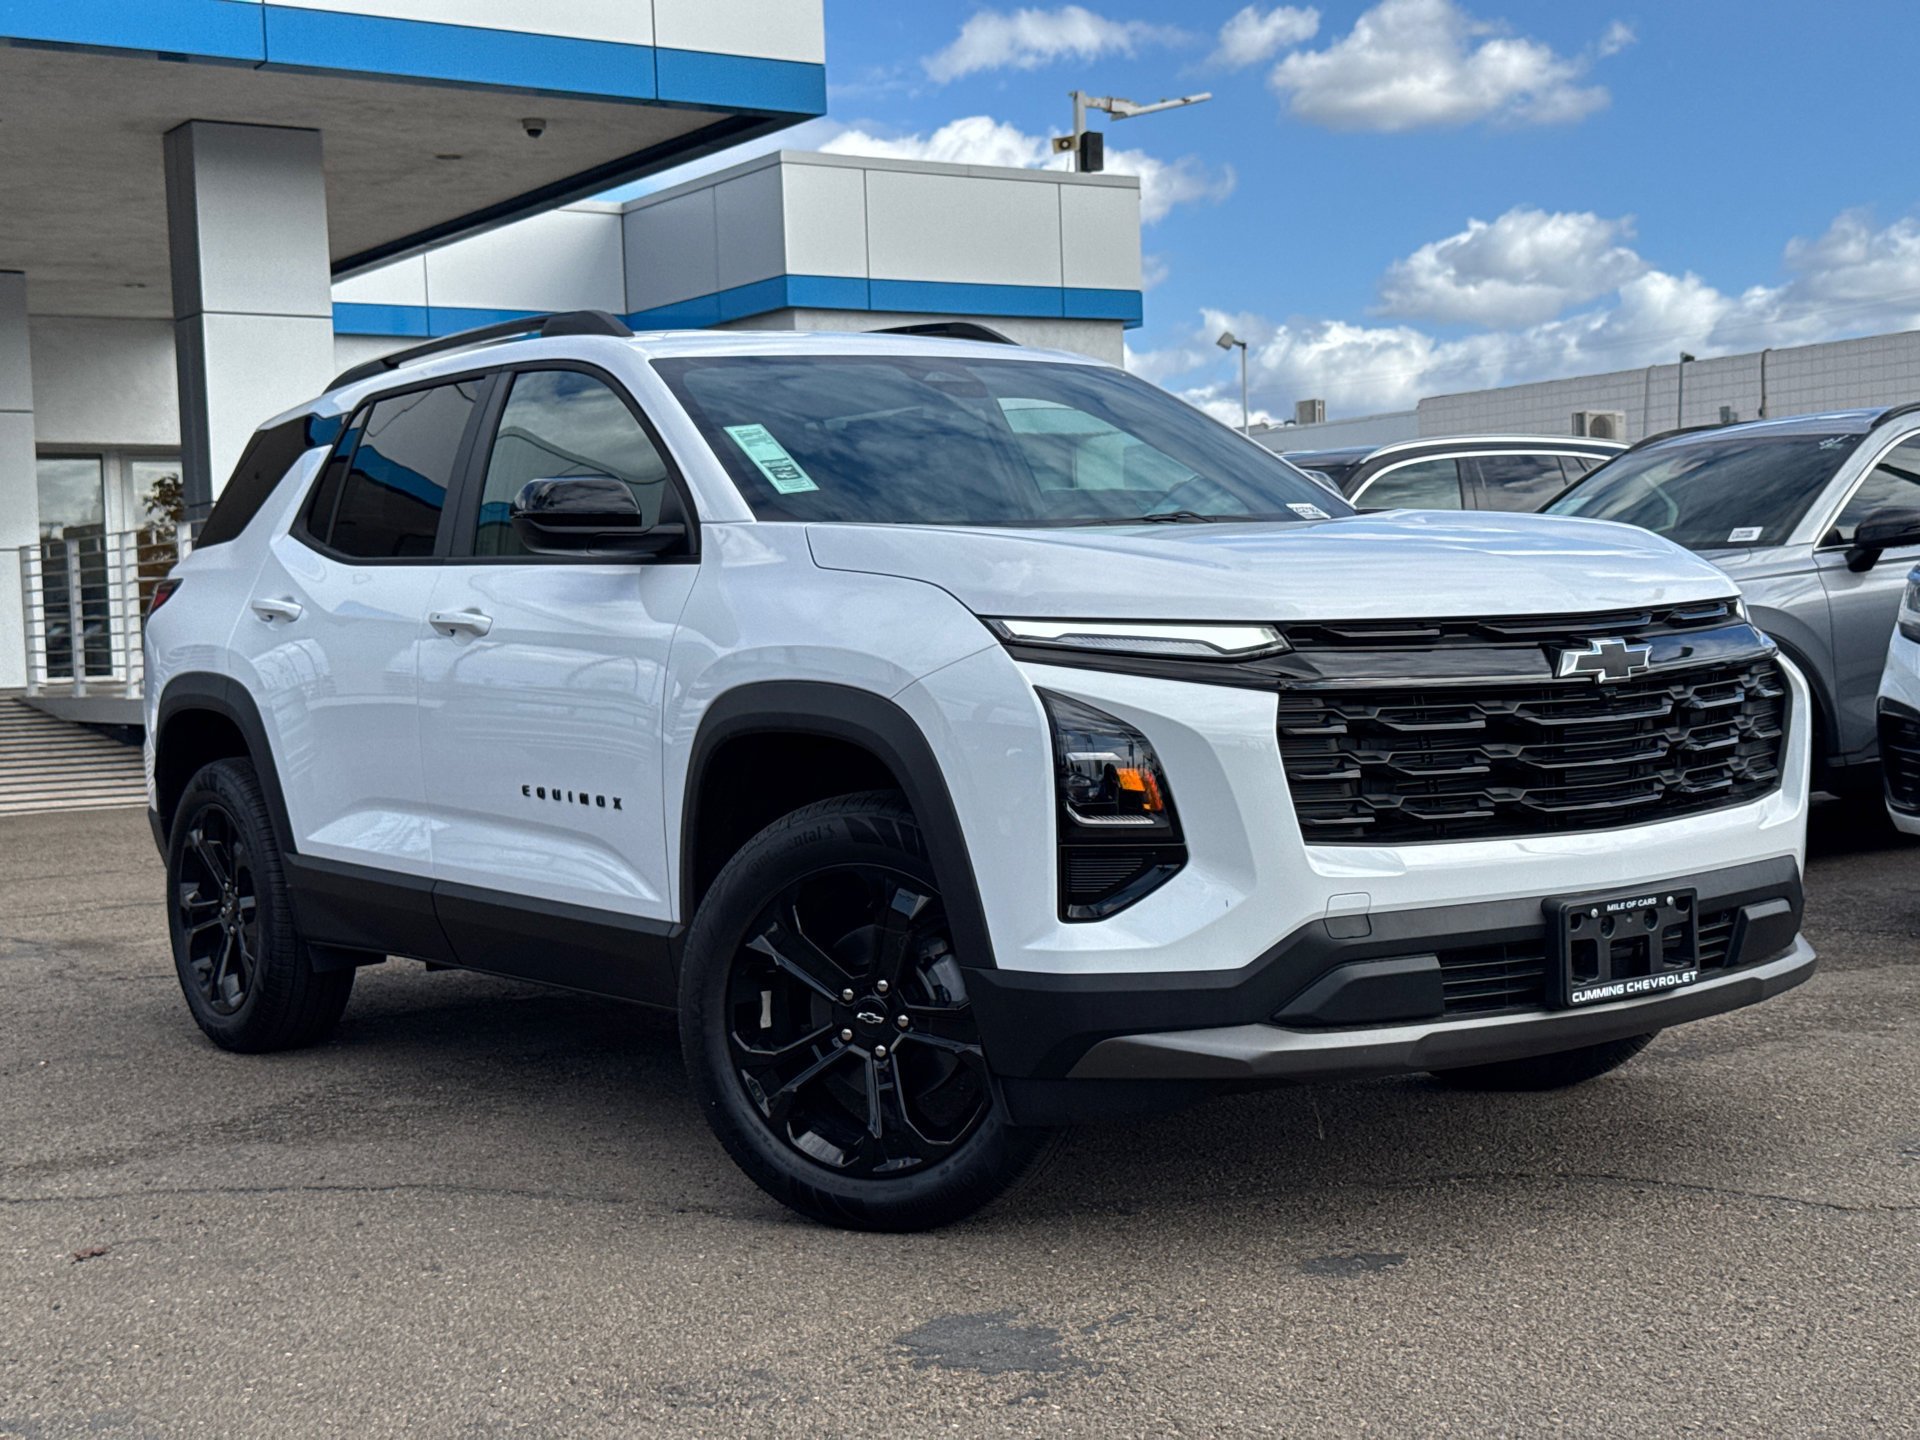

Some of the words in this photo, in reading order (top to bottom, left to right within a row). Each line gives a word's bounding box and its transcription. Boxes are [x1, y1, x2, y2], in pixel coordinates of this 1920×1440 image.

[522, 784, 622, 811] EQUINOX
[1606, 903, 1625, 912] MILE
[1626, 900, 1637, 909] OF
[1637, 897, 1657, 907] CARS
[1572, 984, 1625, 1003] CUMMING
[1626, 971, 1697, 993] CHEVROLET
